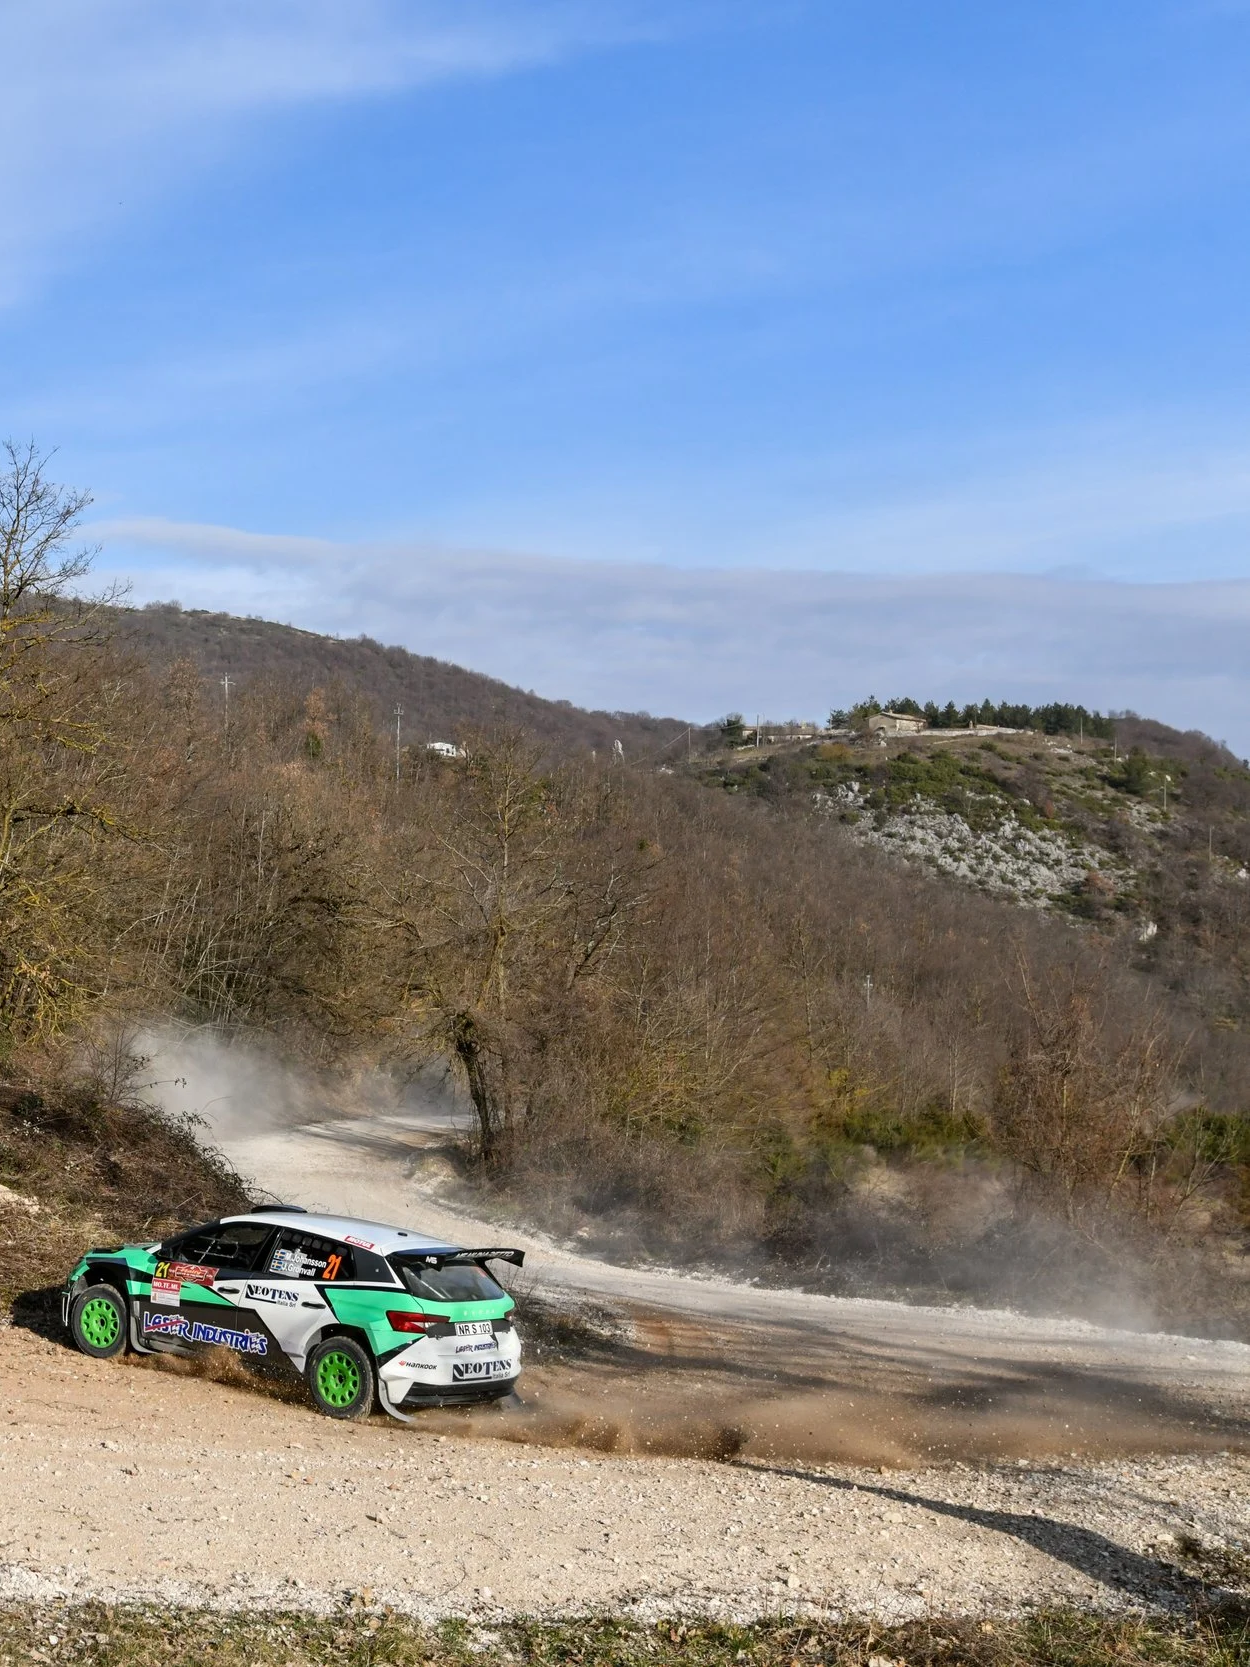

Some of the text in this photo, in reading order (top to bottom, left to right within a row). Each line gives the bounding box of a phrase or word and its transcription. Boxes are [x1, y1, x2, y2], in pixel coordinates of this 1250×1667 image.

[346, 1236, 372, 1249] MOTUL
[155, 1261, 171, 1278] 21
[322, 1253, 342, 1280] 21
[245, 1284, 300, 1302] NEOTENS
[144, 1311, 268, 1355] LASER INDUSTRIES
[458, 1323, 491, 1335] NR S 103
[452, 1358, 512, 1382] NEOTENS
